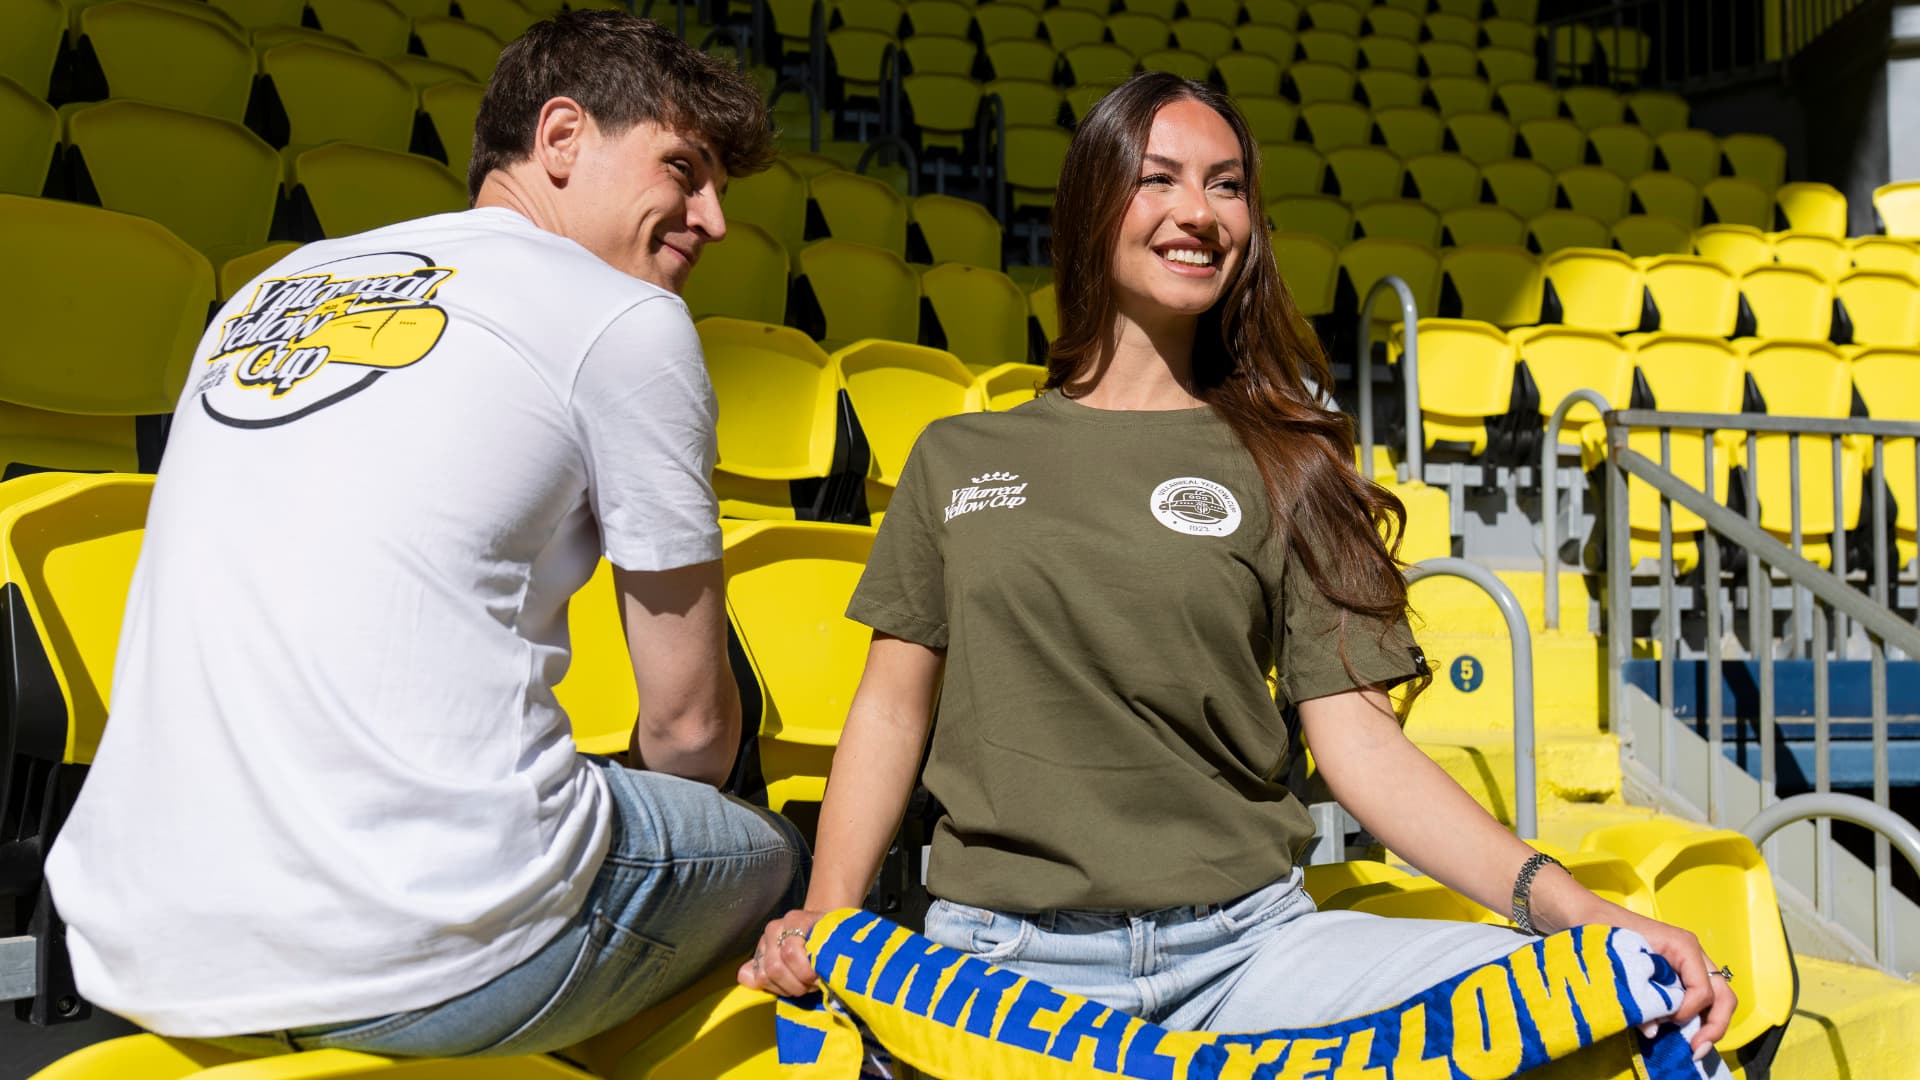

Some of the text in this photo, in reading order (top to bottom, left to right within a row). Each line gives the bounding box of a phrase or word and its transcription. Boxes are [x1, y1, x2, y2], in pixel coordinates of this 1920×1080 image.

[248, 266, 455, 314] Villarreal
[208, 310, 335, 361] Yellow
[236, 341, 331, 395] Cup
[944, 495, 1027, 523] Yellow Cup
[951, 483, 1028, 504] Villarreal
[1460, 659, 1473, 680] 5
[1218, 924, 1629, 1080] YELLOW
